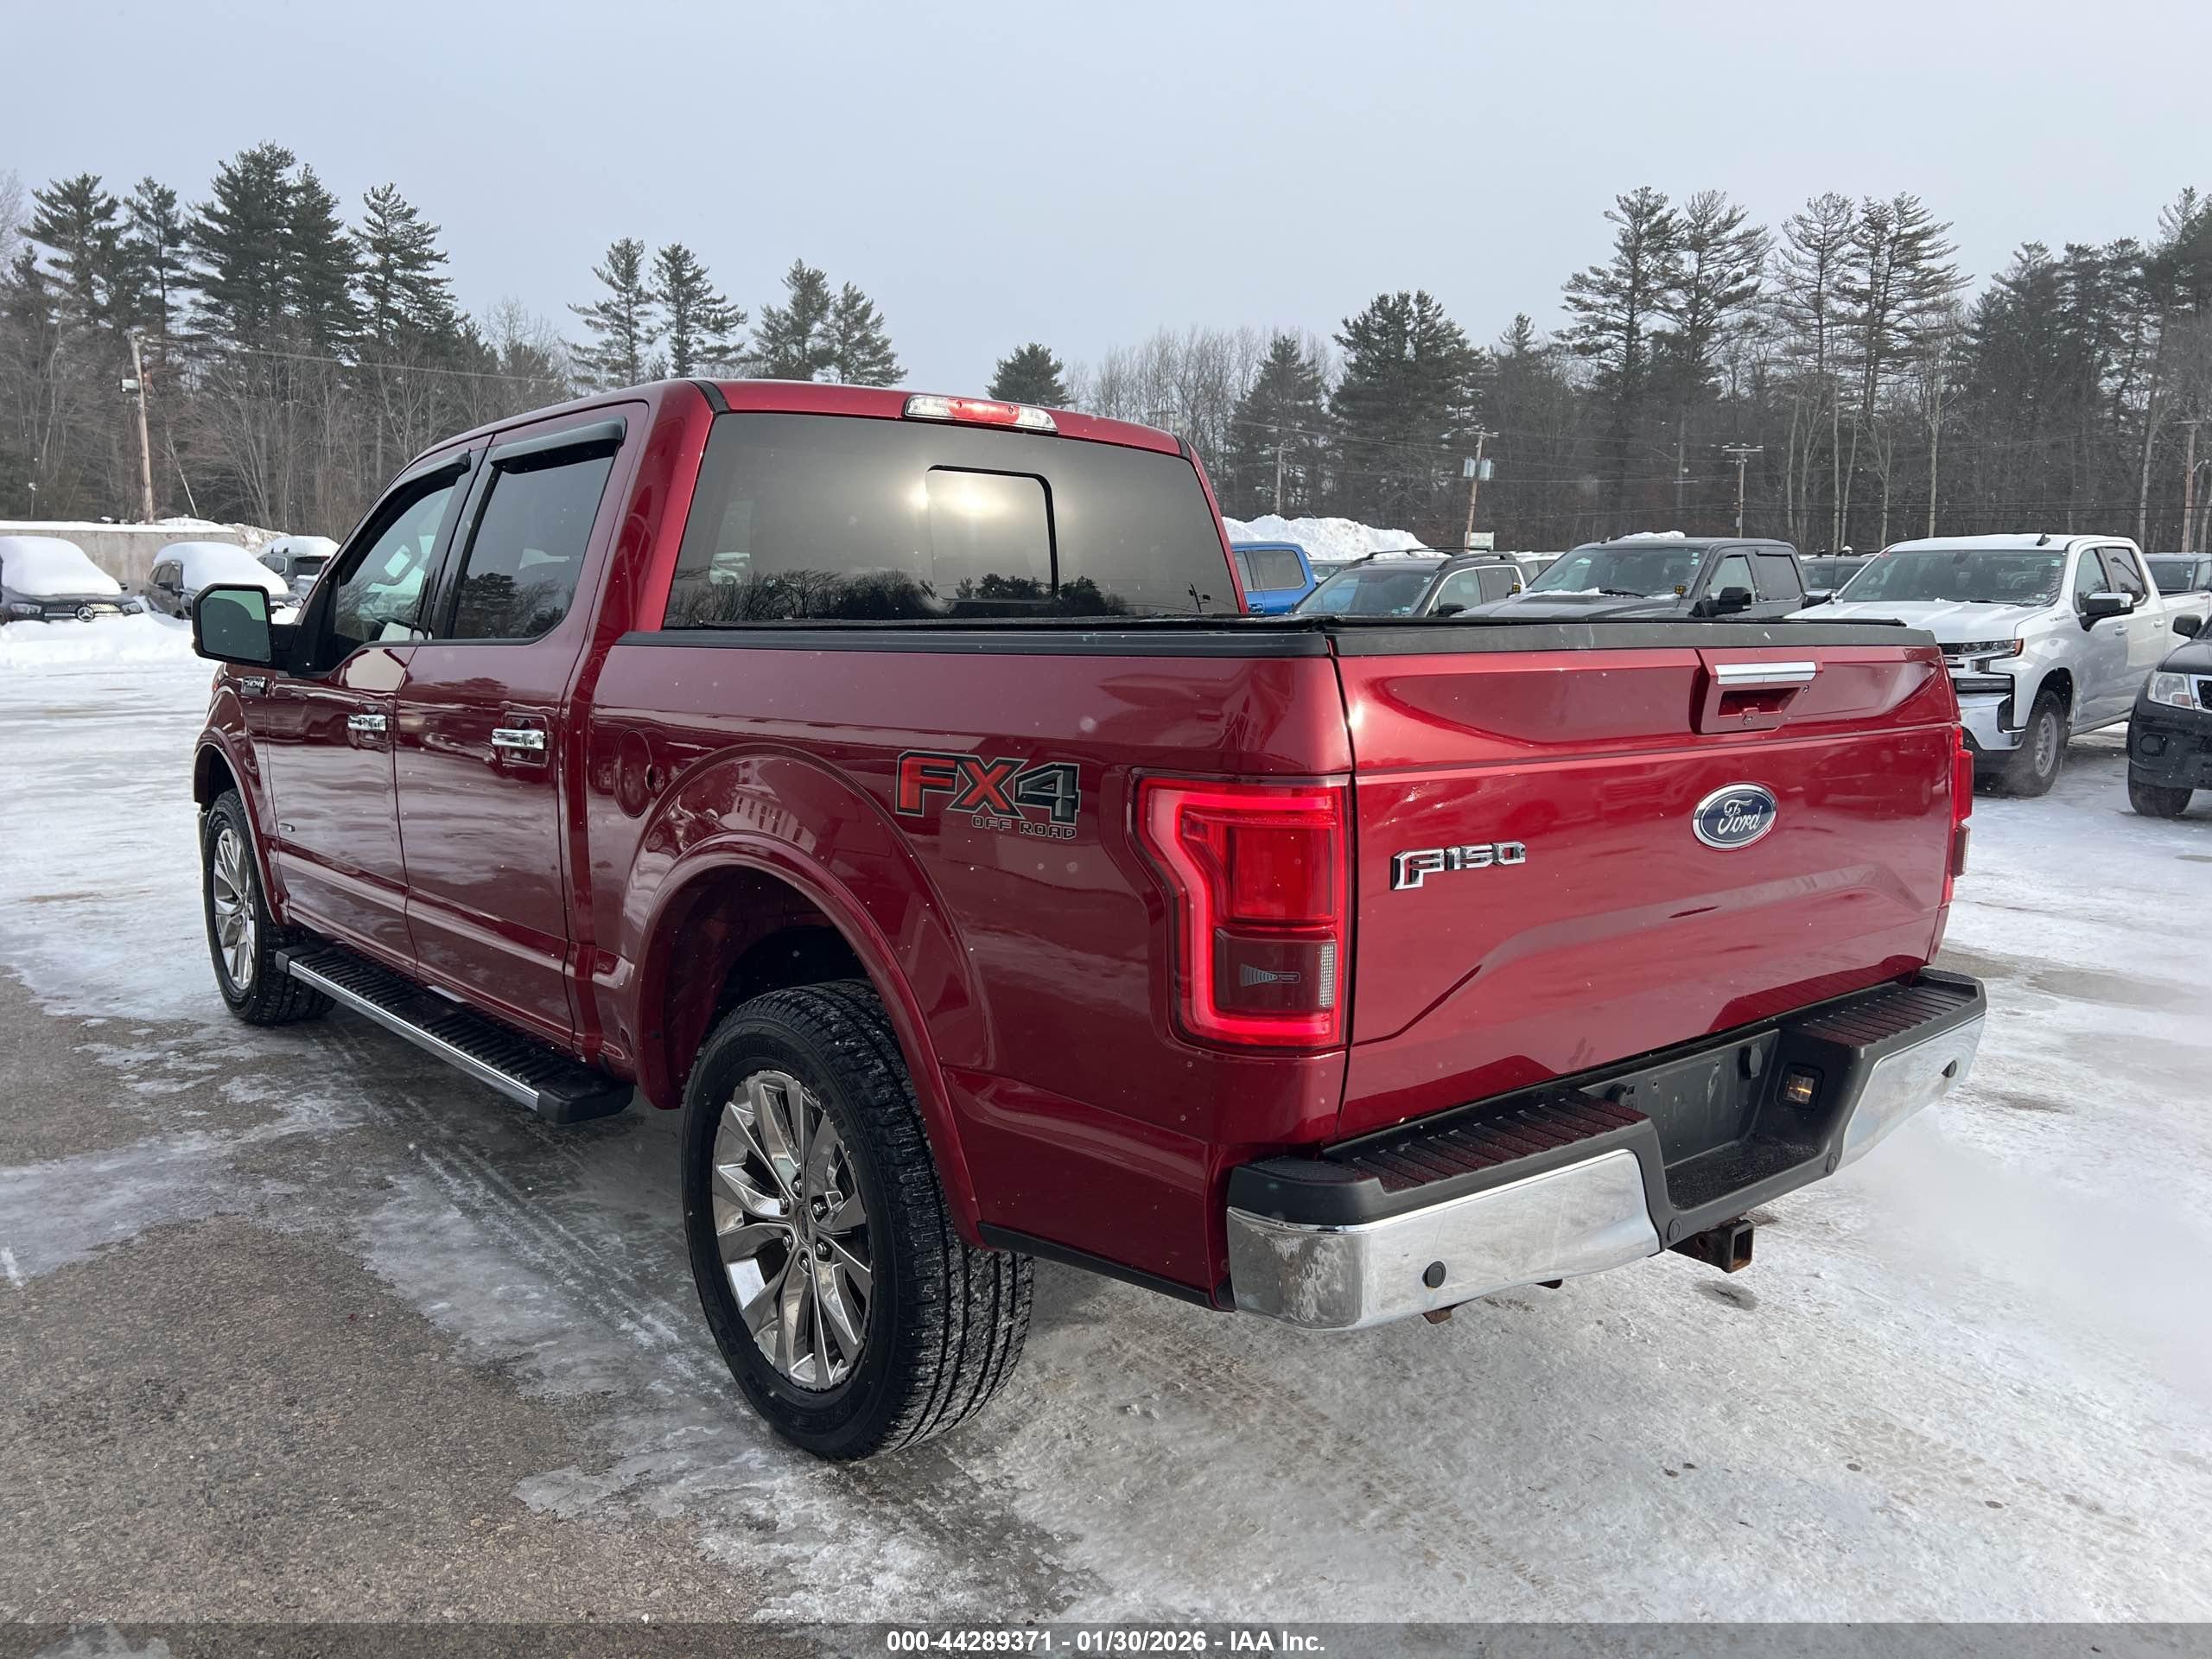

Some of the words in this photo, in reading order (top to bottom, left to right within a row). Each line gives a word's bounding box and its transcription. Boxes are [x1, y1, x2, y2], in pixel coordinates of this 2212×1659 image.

[895, 750, 1081, 826] FX4
[971, 814, 1013, 831] OFF
[1019, 821, 1077, 841] ROAD
[1717, 798, 1764, 836] Ford
